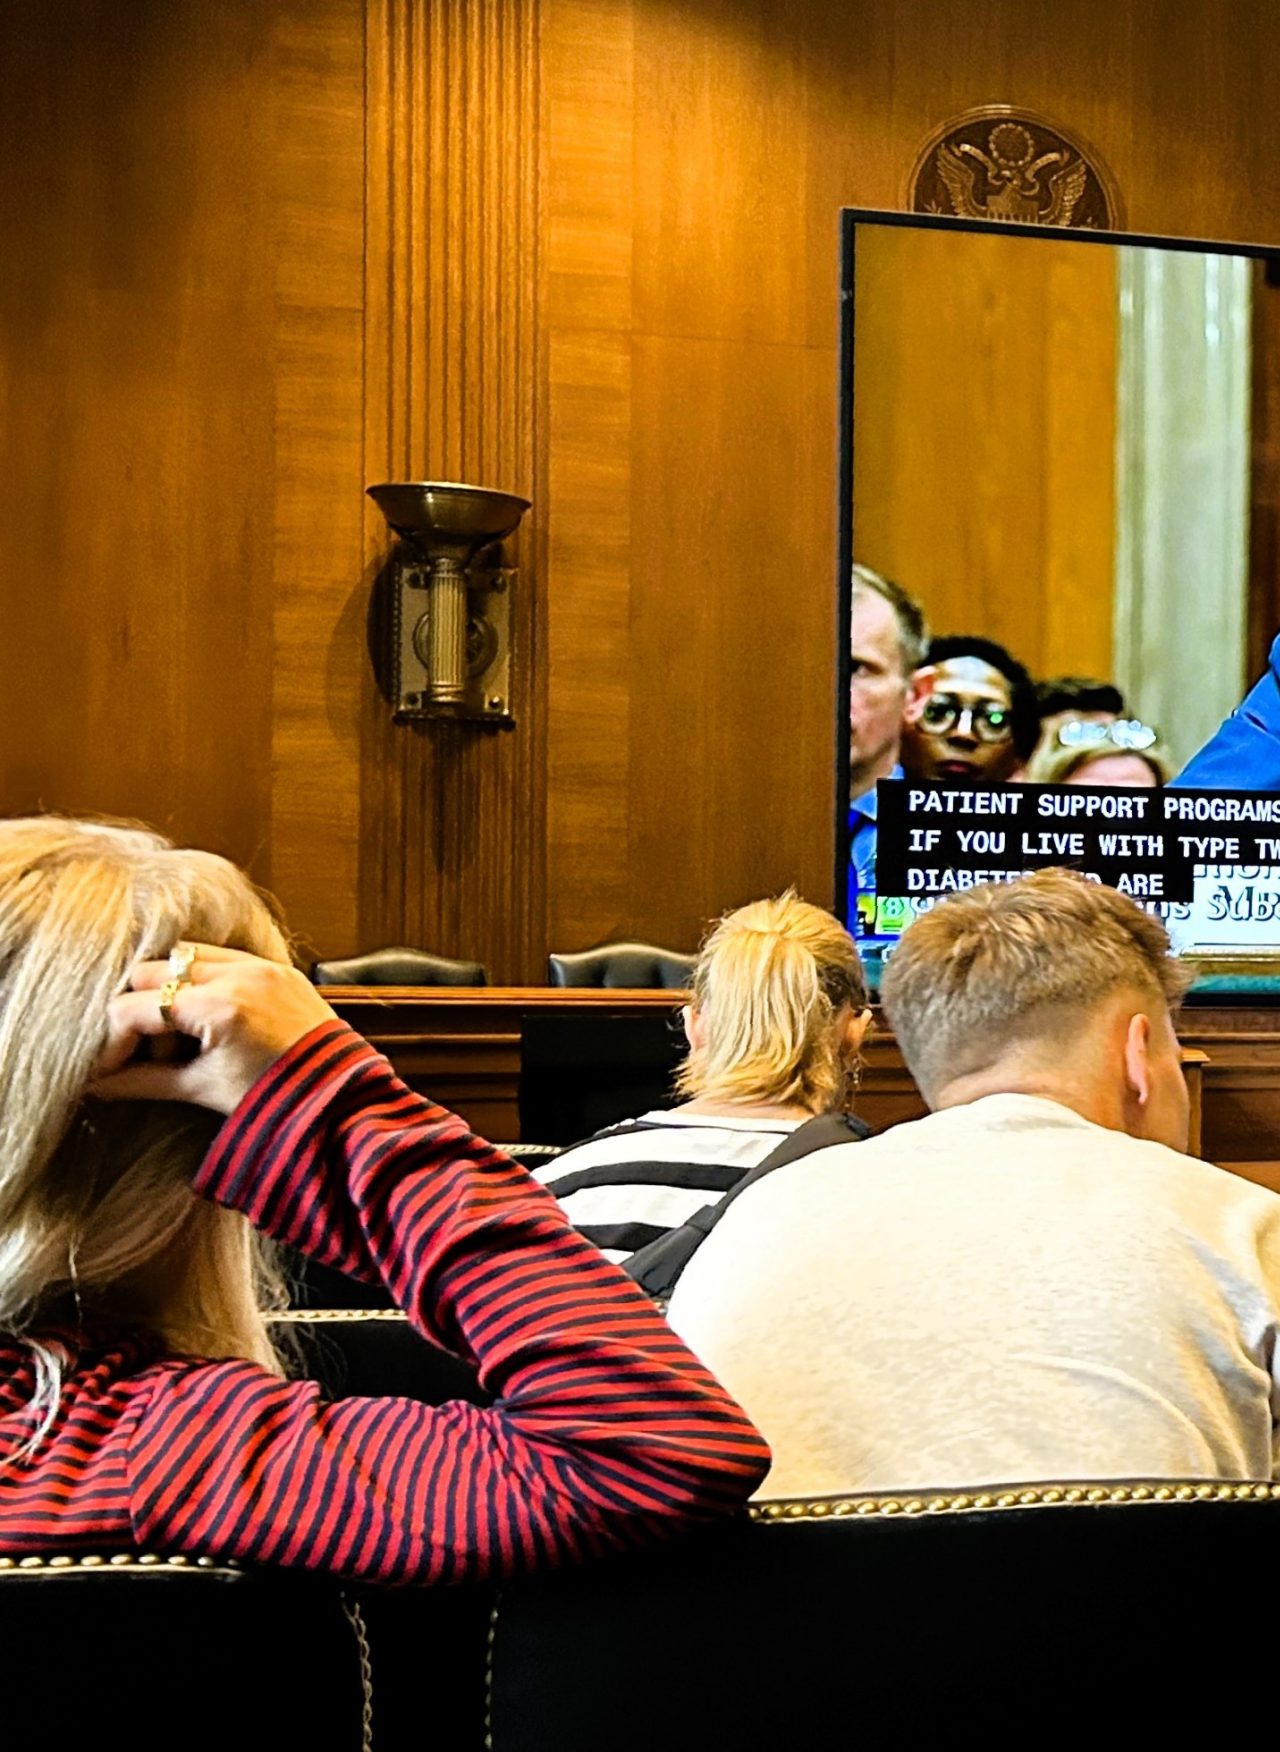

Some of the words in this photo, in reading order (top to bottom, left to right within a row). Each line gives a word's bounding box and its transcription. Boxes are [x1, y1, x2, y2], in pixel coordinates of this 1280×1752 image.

[910, 790, 1023, 814] PATIENT
[1038, 794, 1149, 818] SUPPORT
[909, 829, 941, 851] IF
[957, 831, 1005, 853] YOU
[1022, 833, 1084, 855] LIVE
[1099, 835, 1163, 856] WITH
[1178, 837, 1239, 858] TYPE
[1117, 872, 1164, 896] ARE
